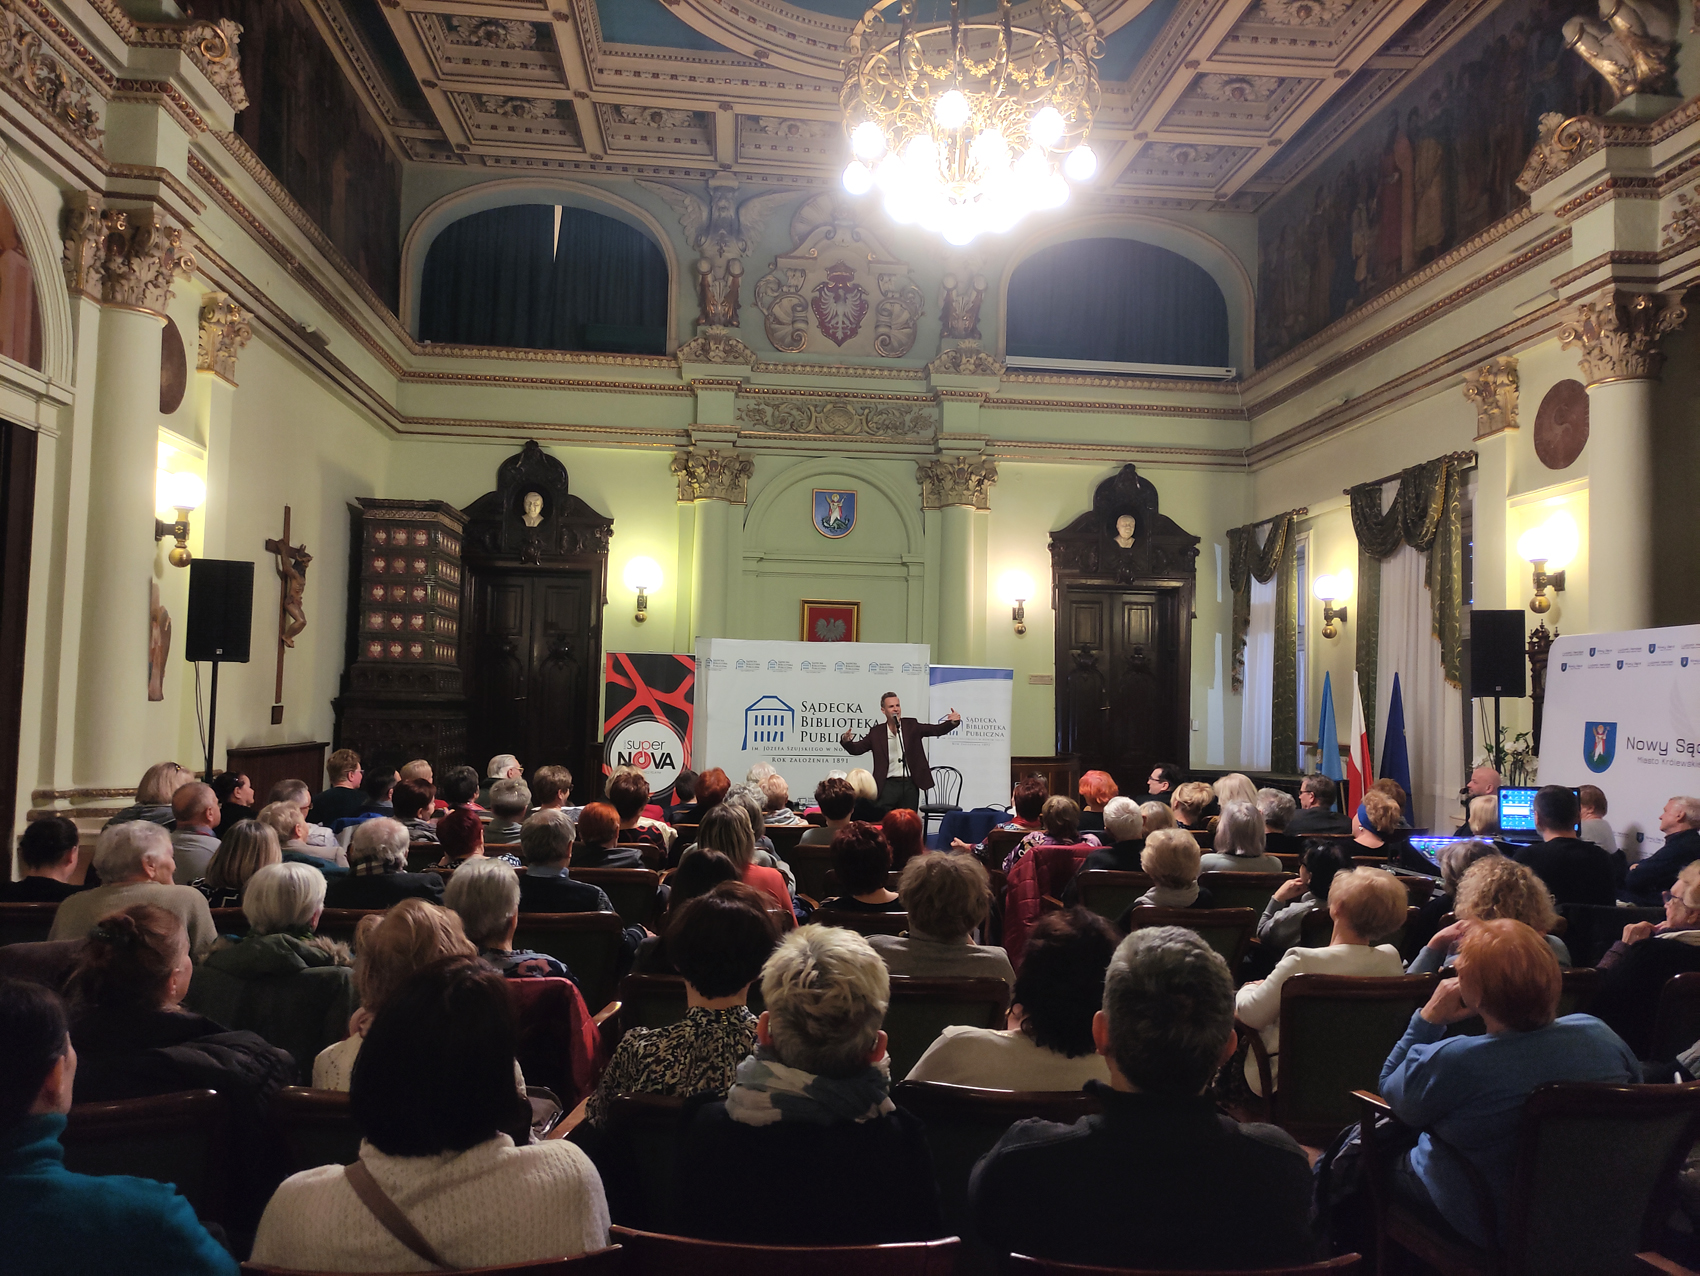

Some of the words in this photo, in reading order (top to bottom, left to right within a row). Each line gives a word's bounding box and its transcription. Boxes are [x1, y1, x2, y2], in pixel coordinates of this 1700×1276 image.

[801, 701, 863, 715] SĄDECKA
[801, 716, 879, 729] BIBLIOTEKA
[627, 740, 665, 750] super
[1626, 737, 1668, 756] Nowy
[618, 751, 676, 770] NOVA
